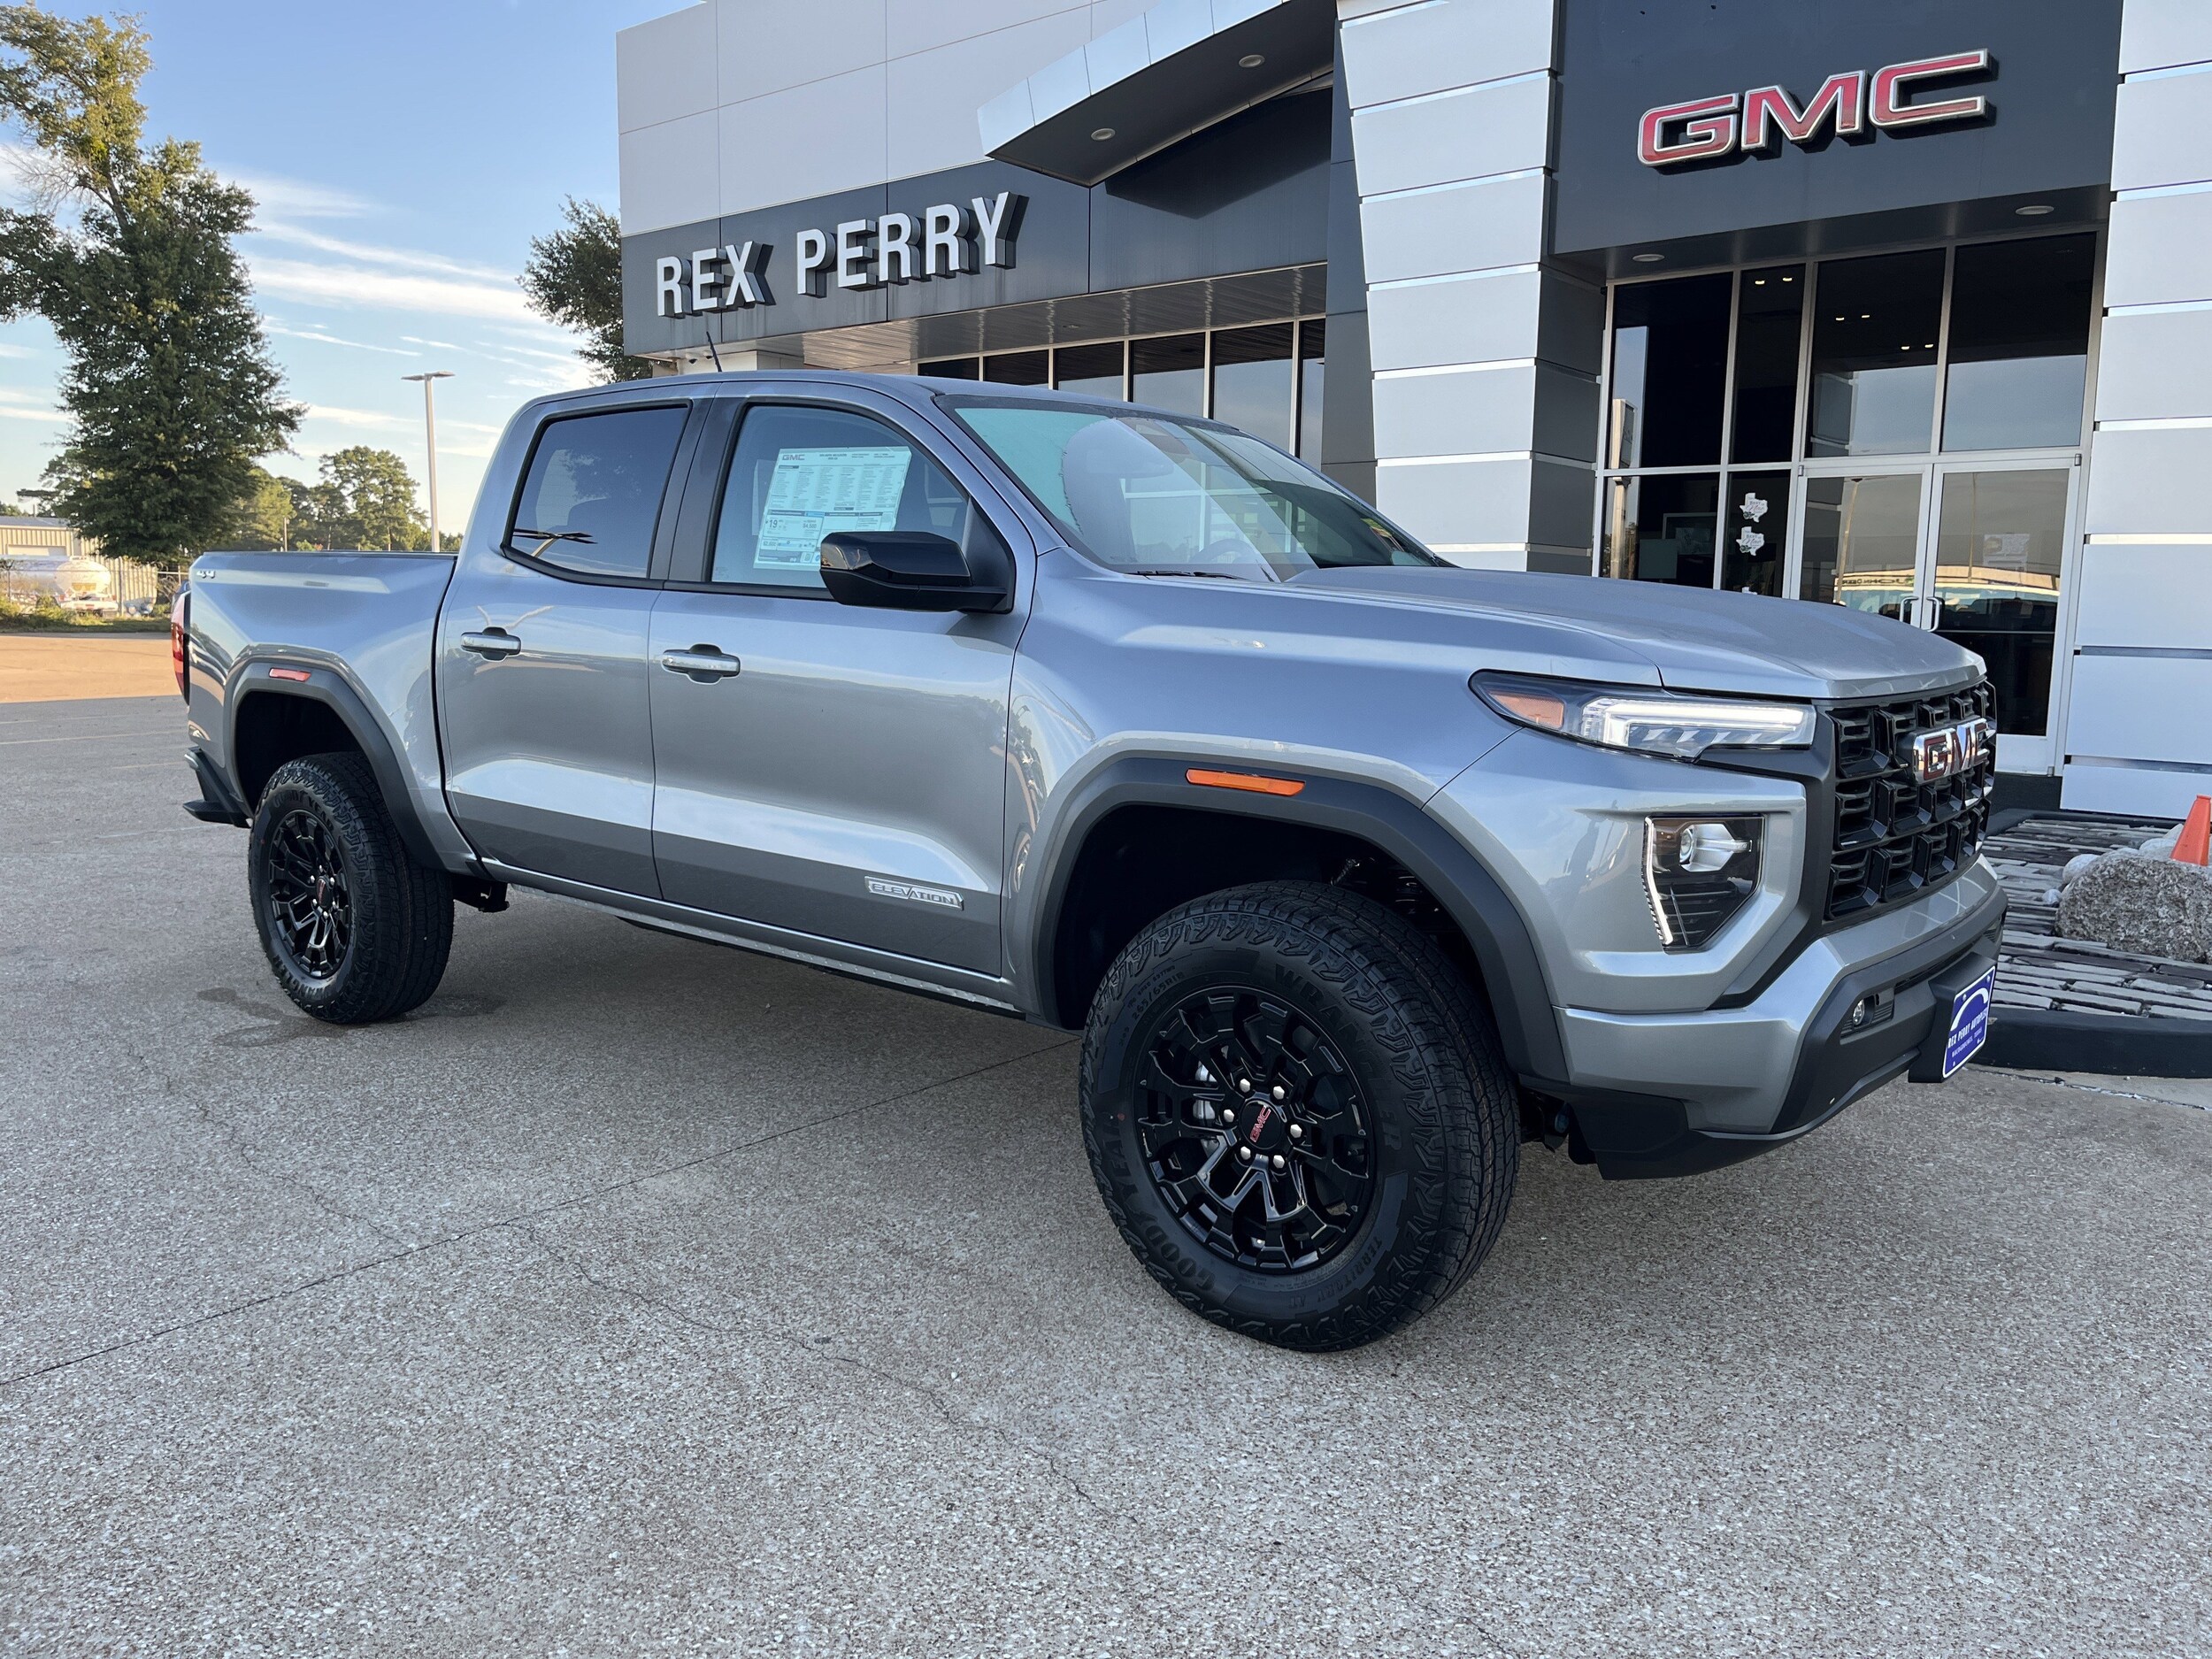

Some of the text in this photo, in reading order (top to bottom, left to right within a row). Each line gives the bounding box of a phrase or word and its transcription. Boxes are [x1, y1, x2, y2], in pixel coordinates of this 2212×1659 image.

[1637, 48, 1989, 167] GMC
[657, 191, 1028, 319] REX PERRY
[770, 519, 778, 528] 19
[1913, 718, 1989, 784] GMC
[872, 883, 955, 905] ELEVATION
[1947, 1033, 1957, 1049] REX
[1957, 1022, 1970, 1042] PERRY
[1250, 1105, 1271, 1142] GMC
[1102, 1111, 1217, 1292] GOODYEAR
